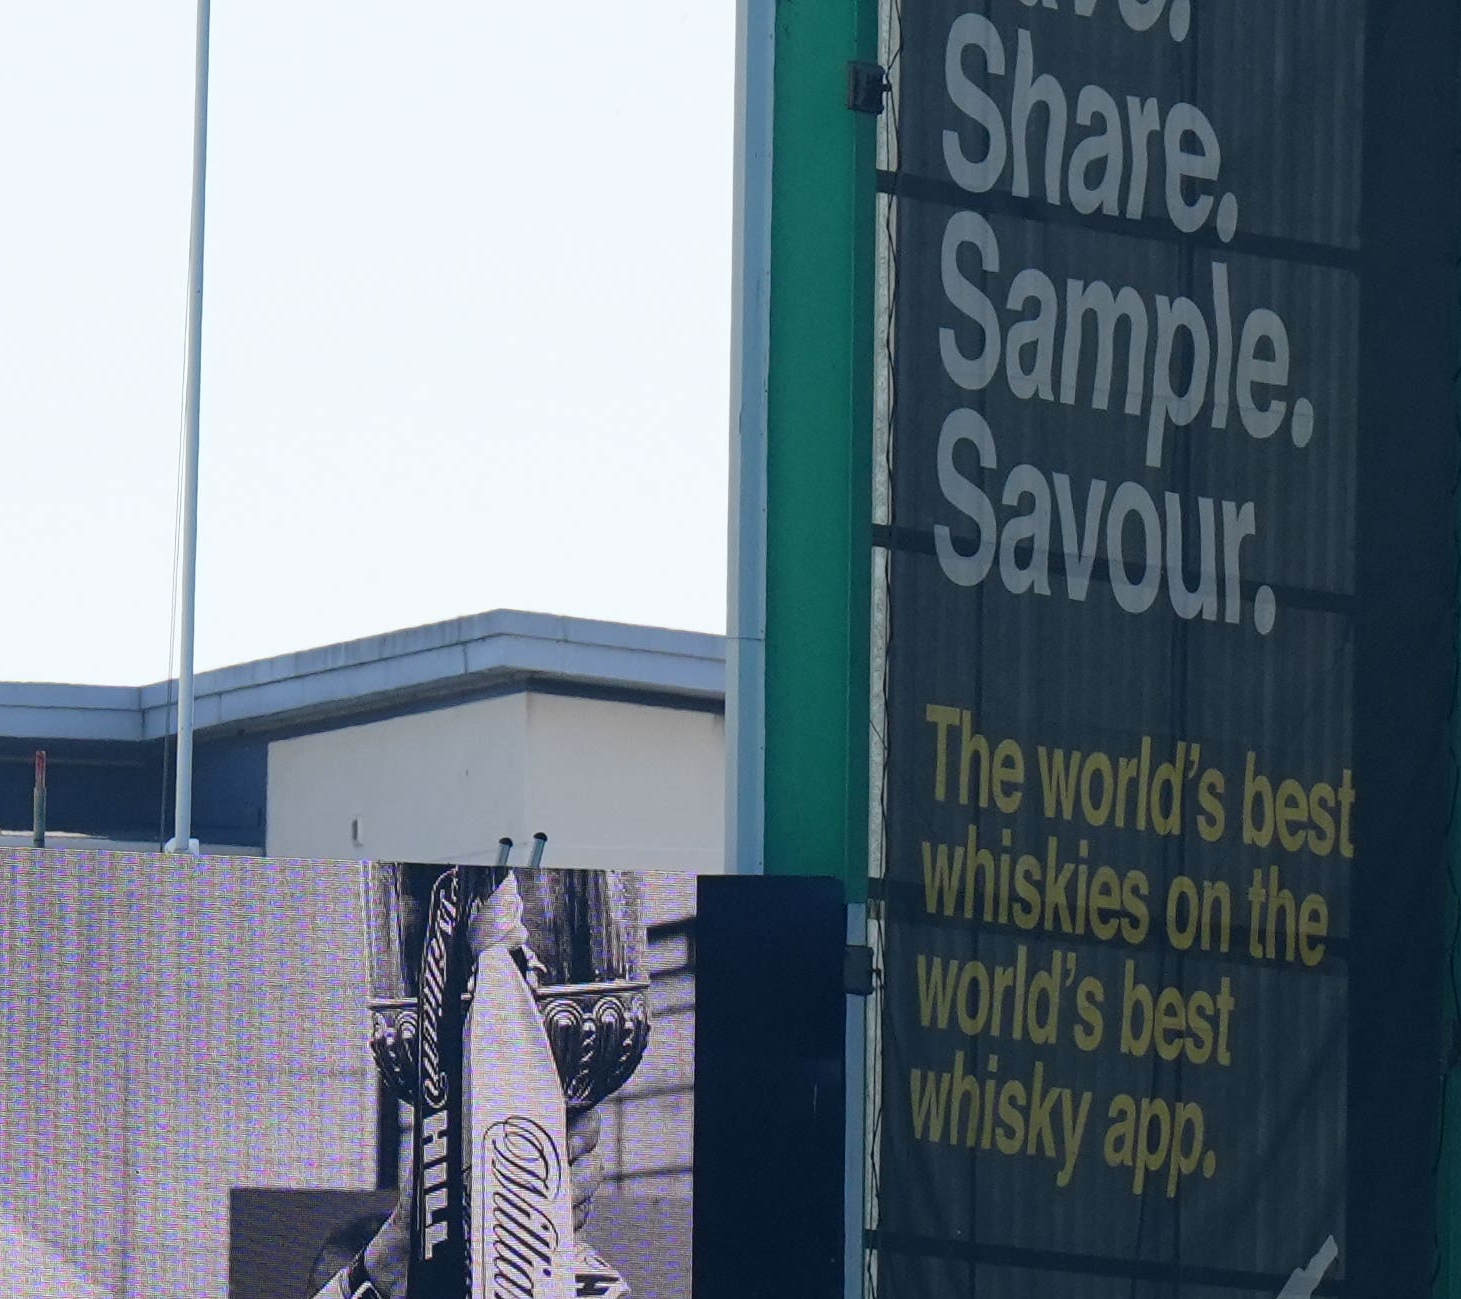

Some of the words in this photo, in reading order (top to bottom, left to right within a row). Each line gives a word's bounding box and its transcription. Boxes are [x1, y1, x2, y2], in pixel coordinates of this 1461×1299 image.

[943, 14, 1239, 243] Share.
[938, 209, 1314, 468] Sample.
[933, 407, 1278, 636] Savour.
[927, 704, 1024, 816] The
[1040, 735, 1226, 846] world's
[1242, 754, 1356, 858] best
[922, 825, 1150, 953] whiskies
[1166, 875, 1231, 953] on
[1249, 866, 1331, 967] the
[917, 943, 1105, 1054] world's
[1119, 963, 1235, 1068] best
[421, 1109, 449, 1260] HILL
[910, 1053, 1094, 1189] whisky
[1104, 1093, 1218, 1200] app.
